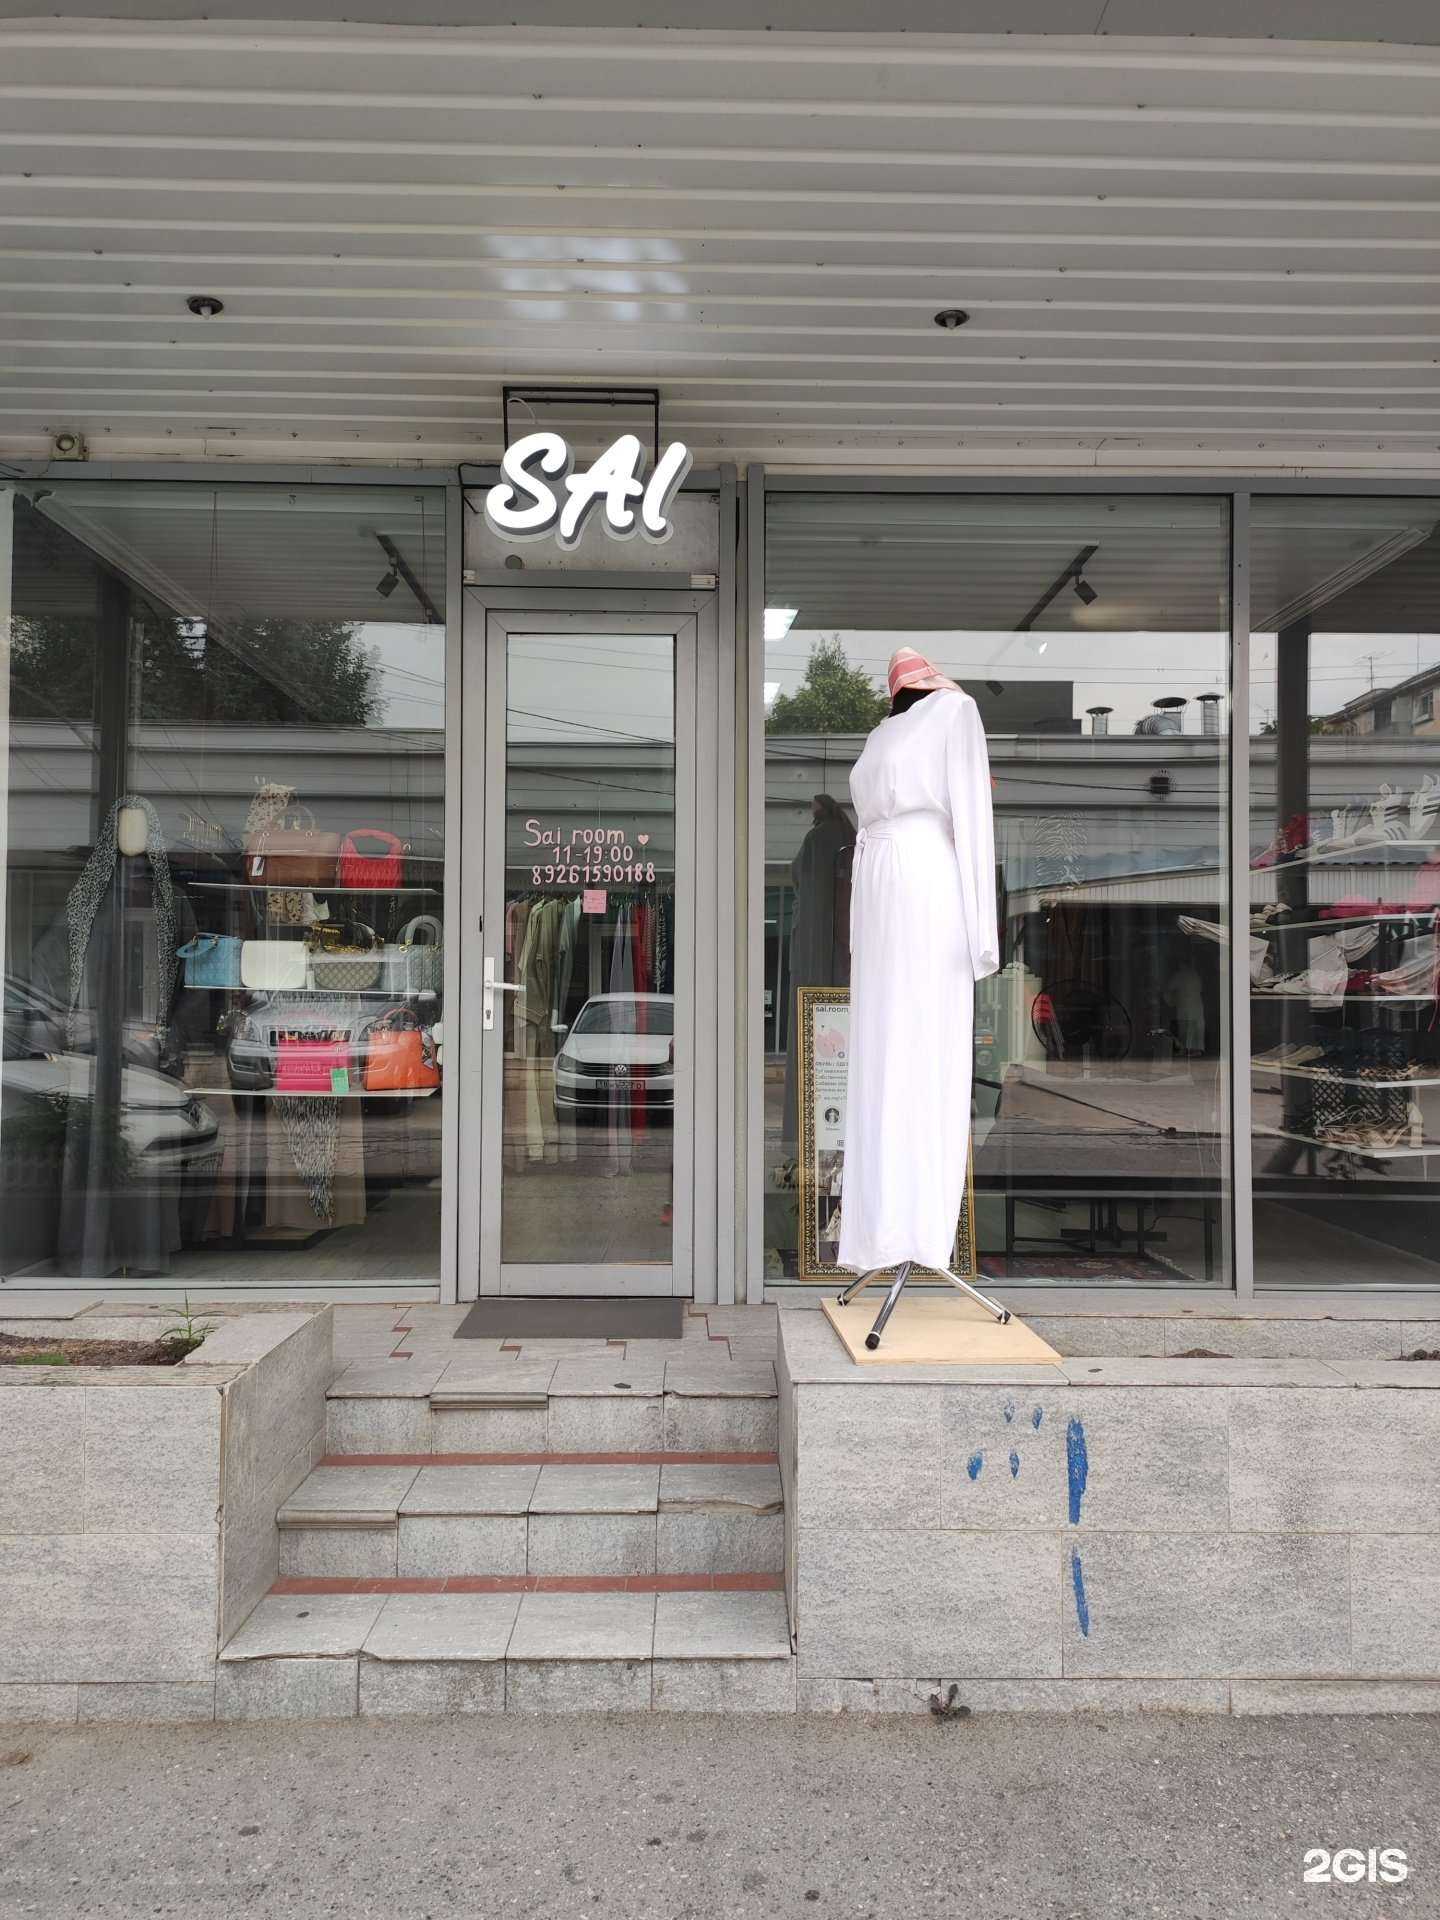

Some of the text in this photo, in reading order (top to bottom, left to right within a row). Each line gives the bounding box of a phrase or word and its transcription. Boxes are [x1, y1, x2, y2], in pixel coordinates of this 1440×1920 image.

[523, 818, 625, 847] Sai room
[532, 862, 656, 886] 89261590188
